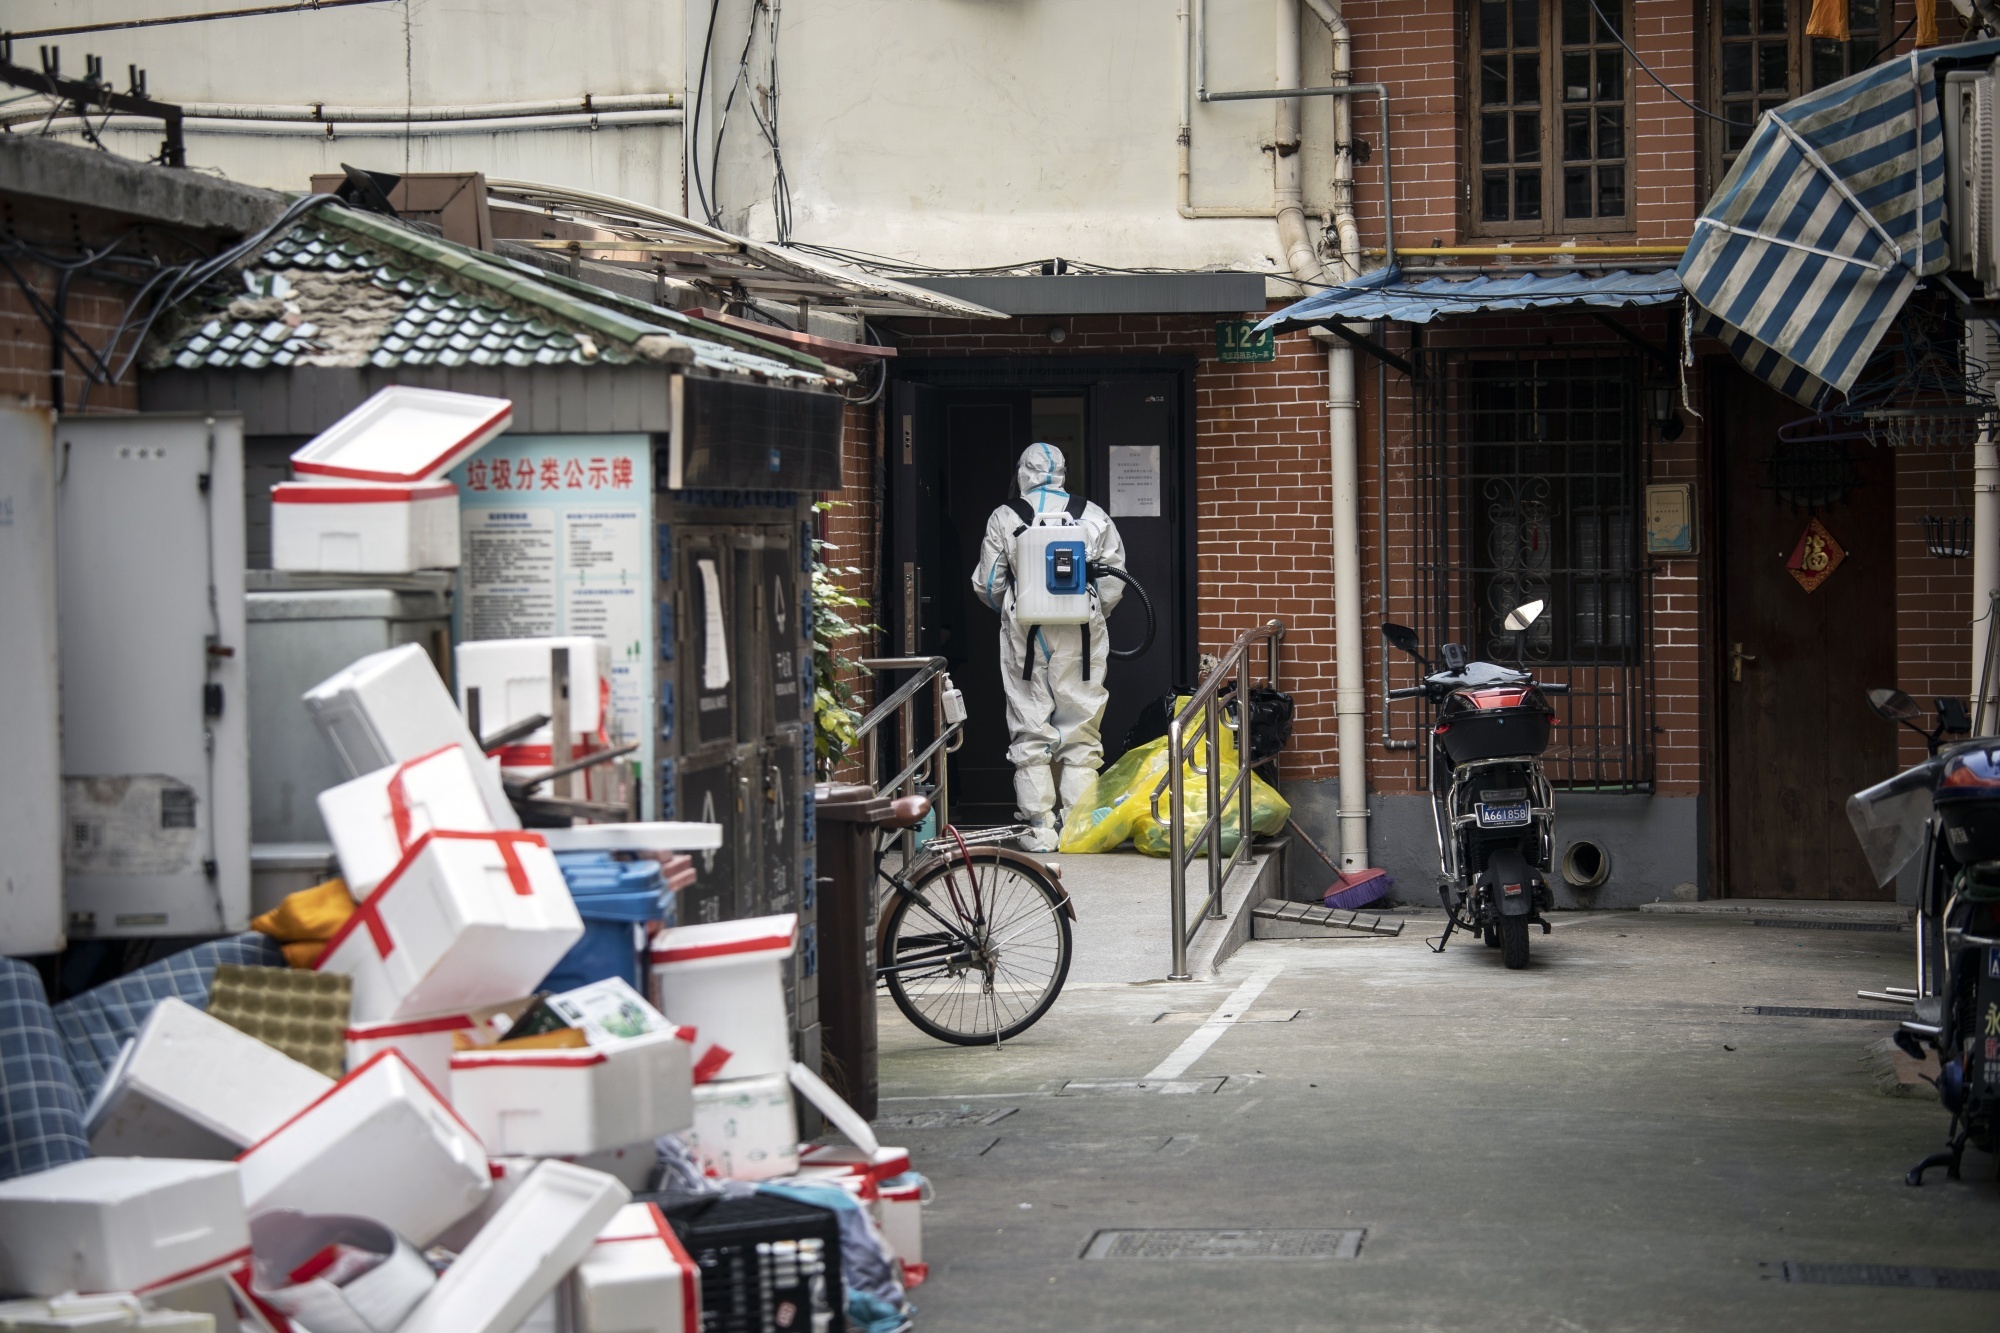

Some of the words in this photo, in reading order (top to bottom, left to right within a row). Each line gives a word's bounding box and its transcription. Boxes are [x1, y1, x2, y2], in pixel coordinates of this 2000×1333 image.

[466, 457, 634, 492] 垃圾分类公示牌
[1801, 534, 1830, 571] 福
[1484, 808, 1527, 821] A661858
